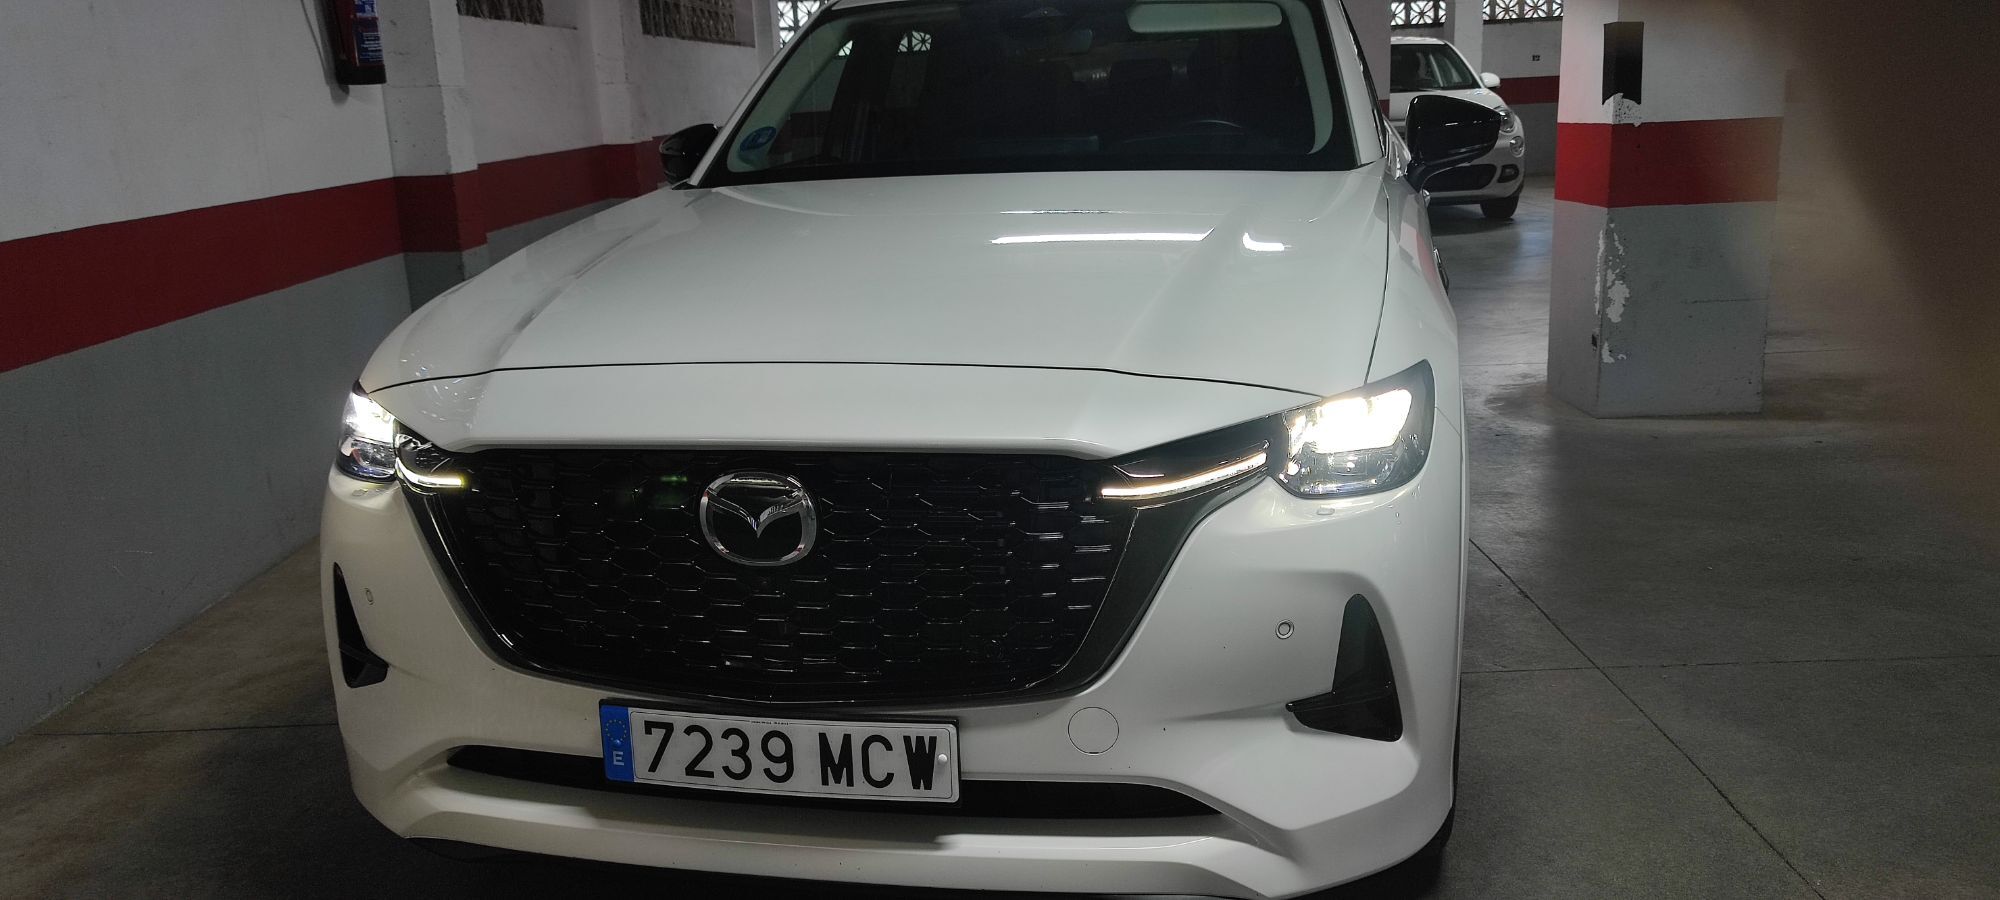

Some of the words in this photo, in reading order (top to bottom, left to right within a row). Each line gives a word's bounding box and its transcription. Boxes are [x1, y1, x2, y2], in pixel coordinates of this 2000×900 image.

[613, 751, 624, 766] E
[644, 720, 794, 784] 7239
[819, 732, 937, 790] MCW
